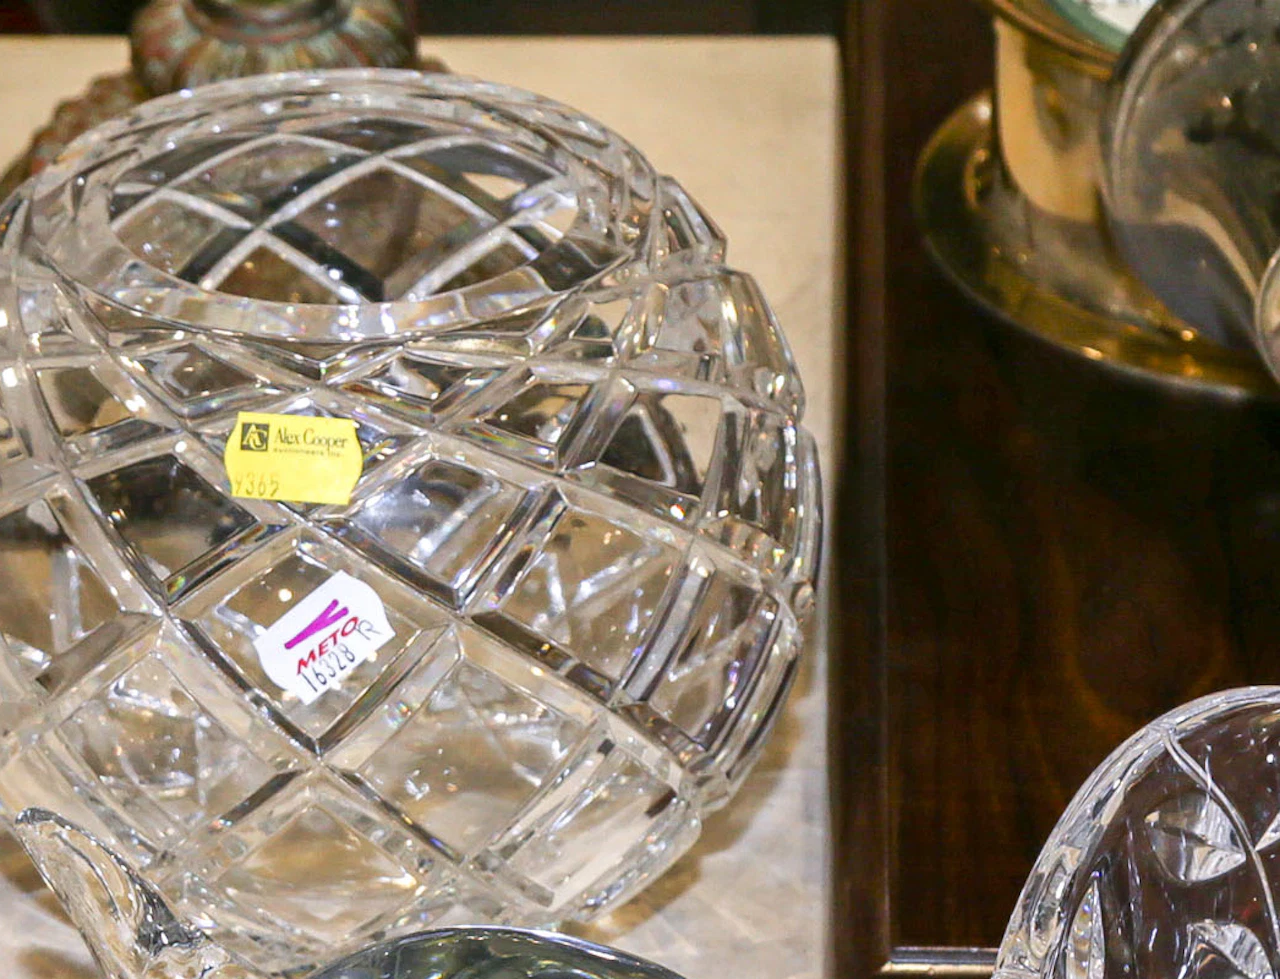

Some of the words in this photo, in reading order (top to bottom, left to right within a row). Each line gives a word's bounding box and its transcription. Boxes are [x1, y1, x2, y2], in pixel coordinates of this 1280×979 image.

[274, 427, 300, 445] Alex
[303, 428, 348, 451] Cooper
[297, 616, 358, 675] METO
[301, 642, 355, 692] 16328
